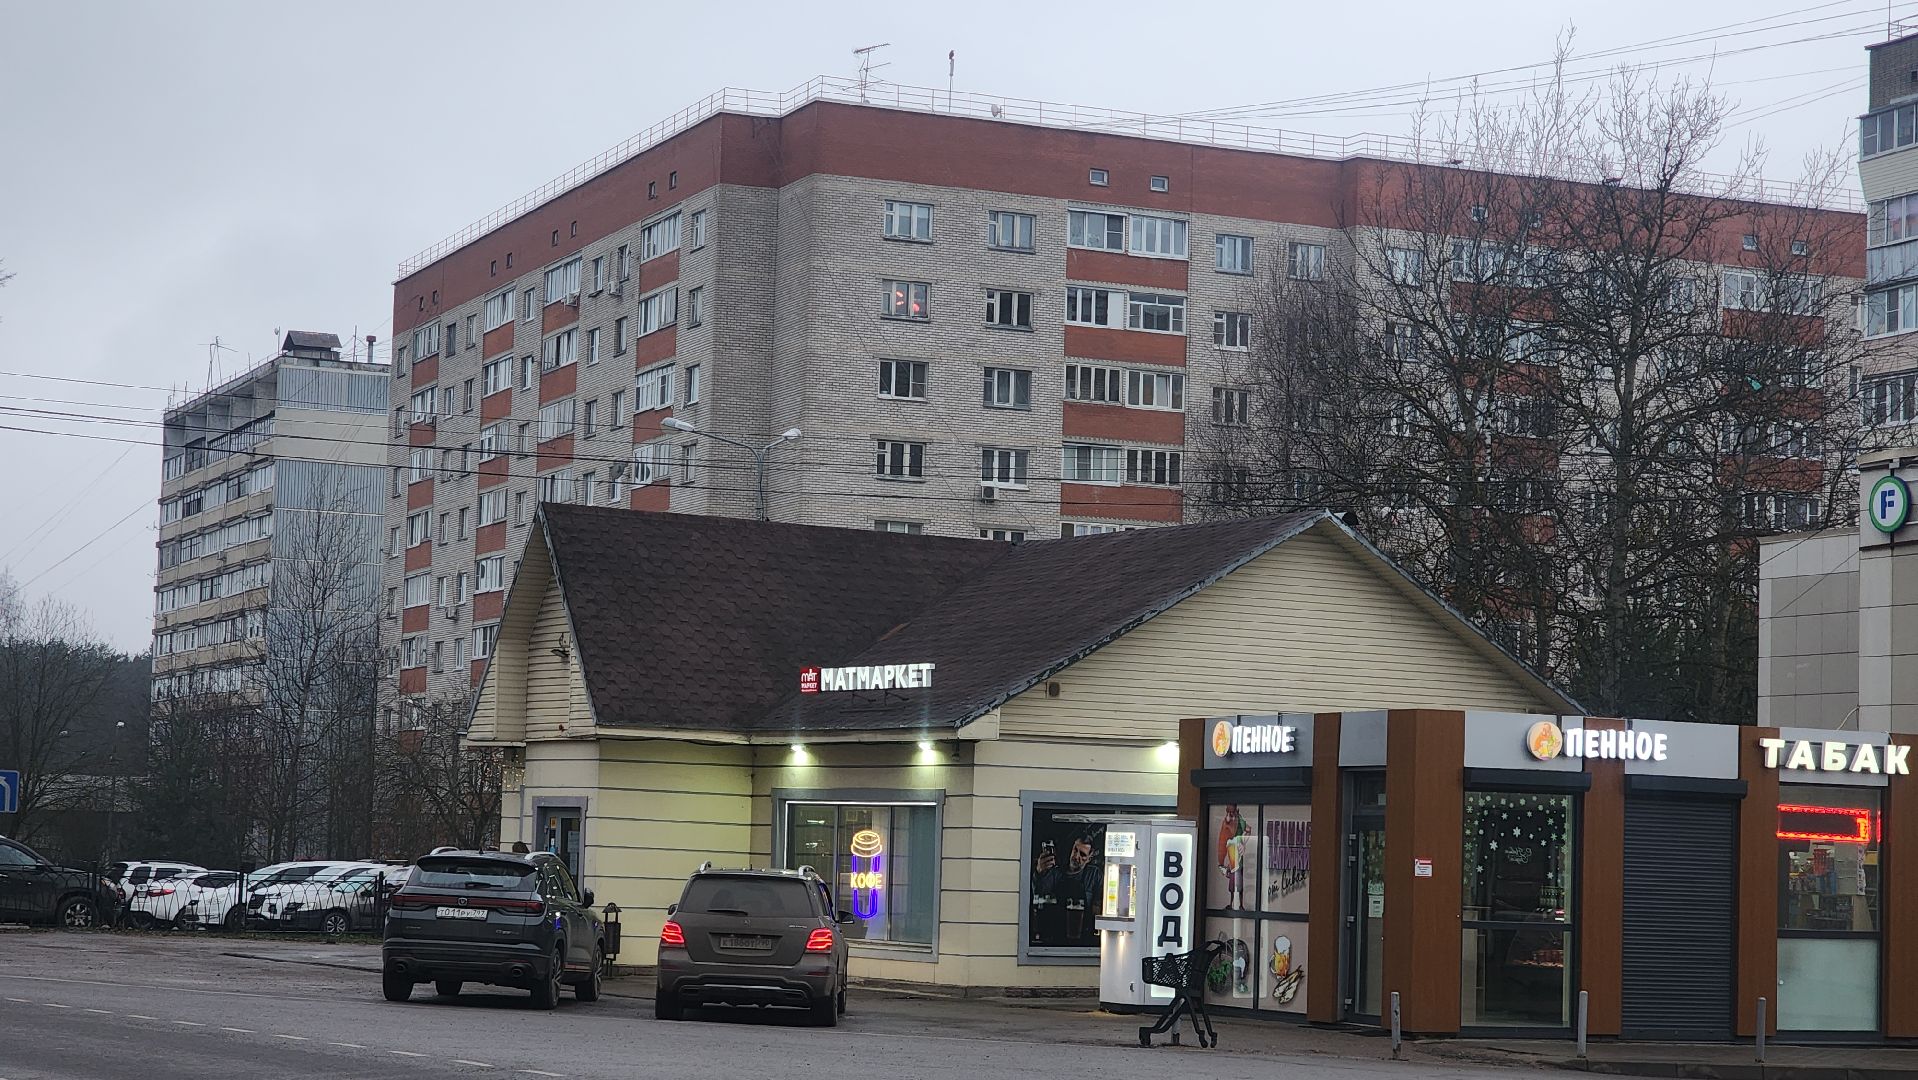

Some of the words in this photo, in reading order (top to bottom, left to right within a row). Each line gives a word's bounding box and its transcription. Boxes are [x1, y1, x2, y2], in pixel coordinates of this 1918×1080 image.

[820, 663, 935, 692] МАТМАРКЕТ
[1231, 725, 1296, 753] ПЕННОЕ
[1566, 728, 1668, 761] ПЕННОЕ
[1760, 738, 1911, 775] ТАБАК
[850, 872, 883, 888] КОФЕ
